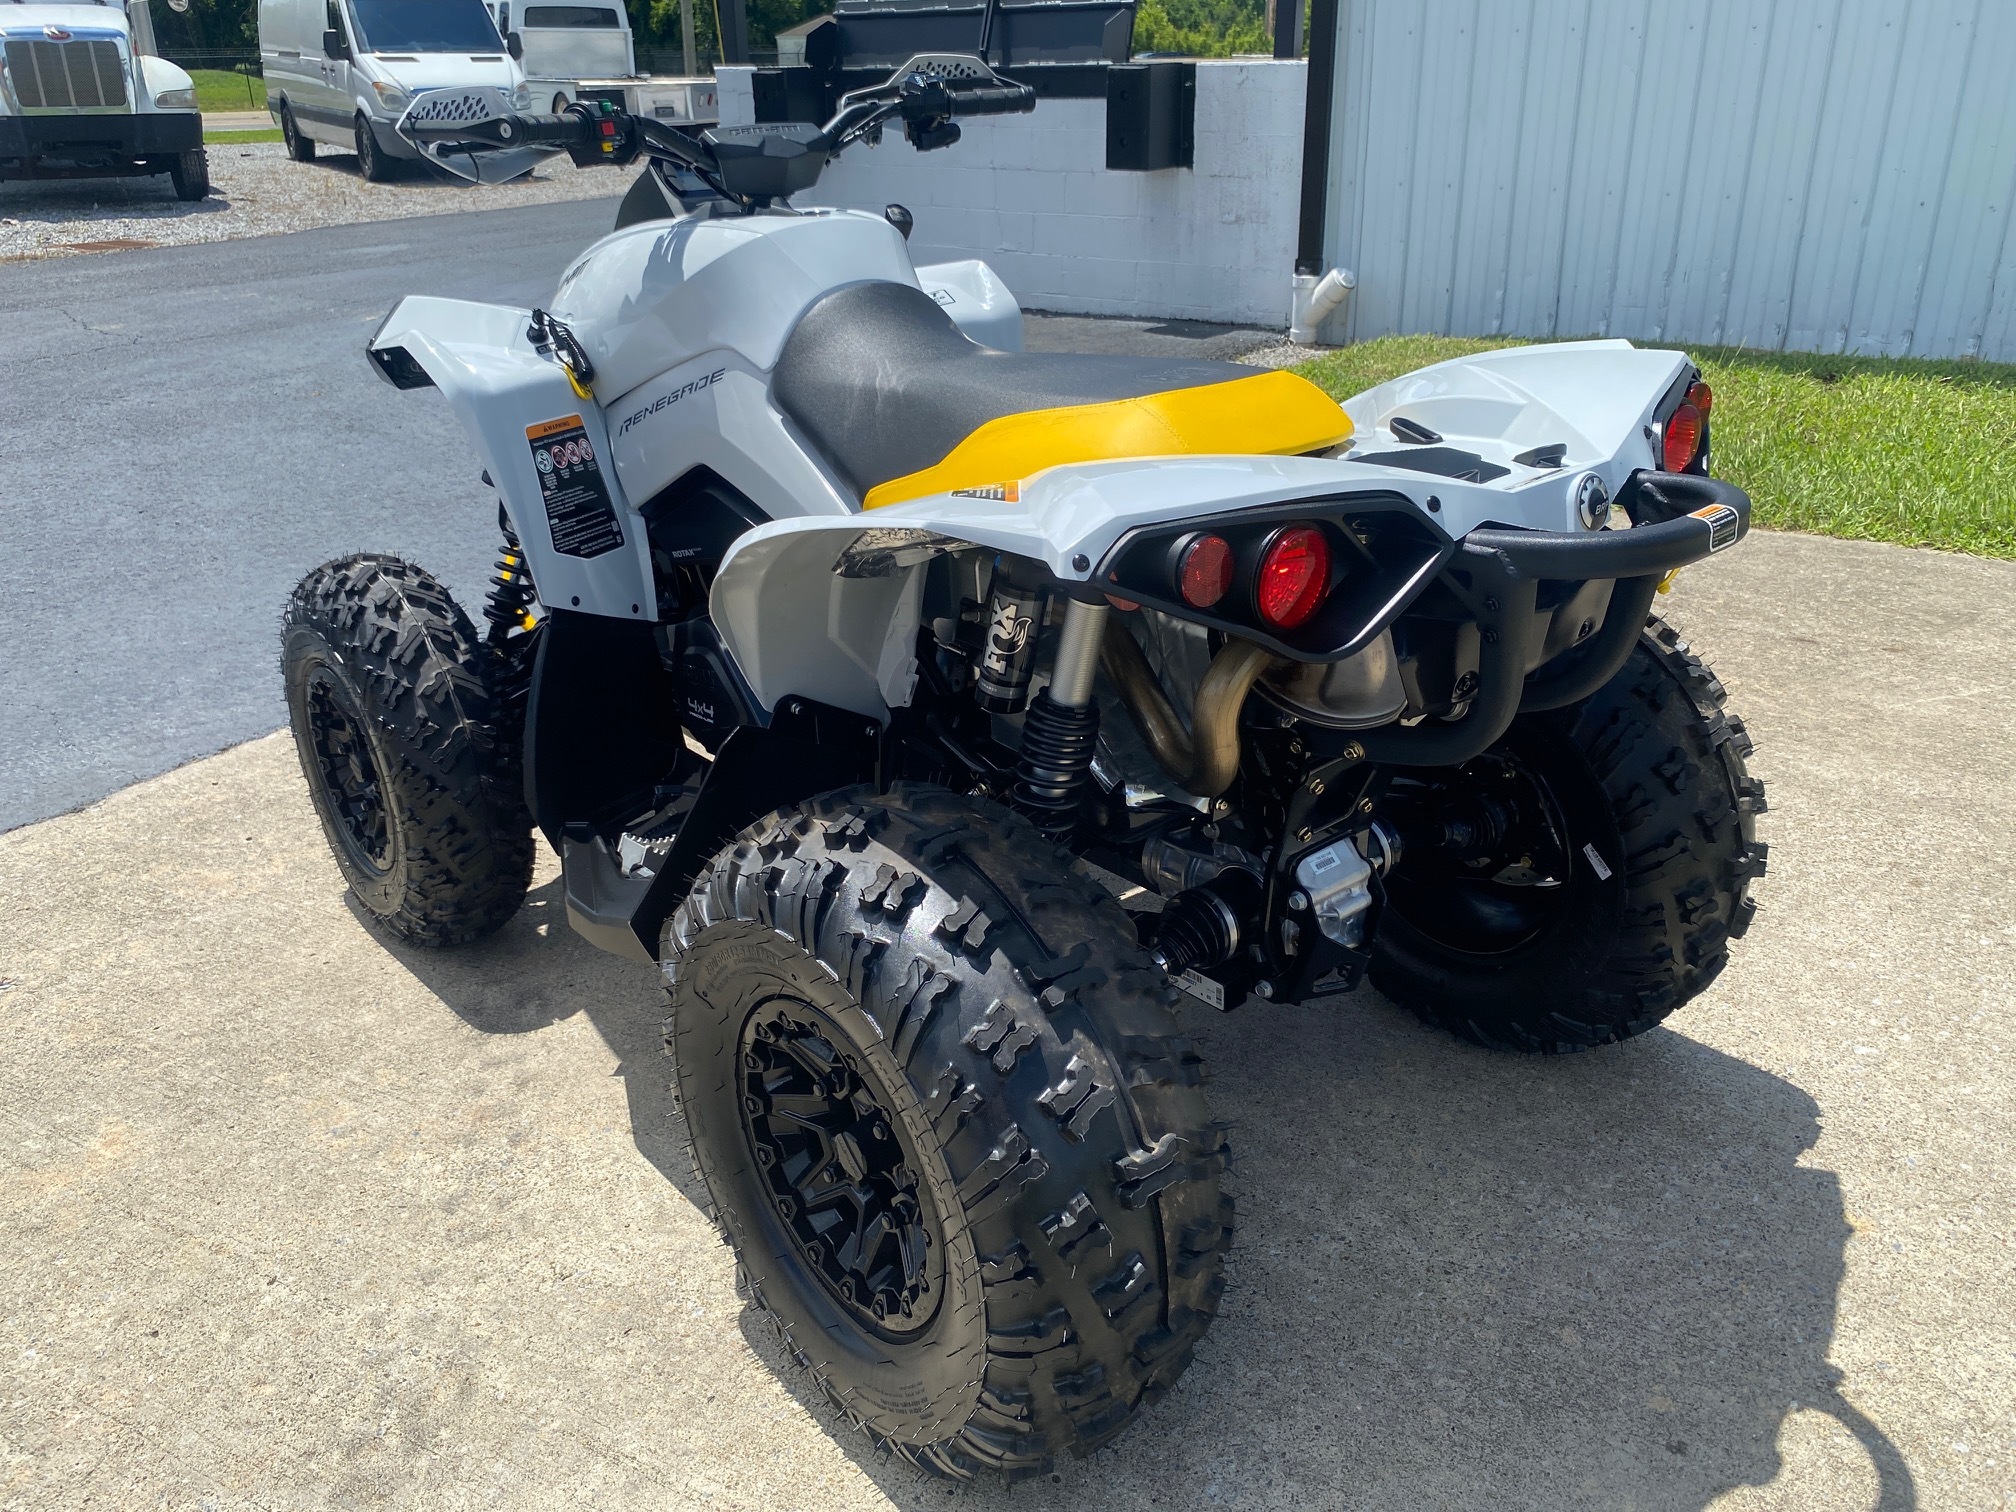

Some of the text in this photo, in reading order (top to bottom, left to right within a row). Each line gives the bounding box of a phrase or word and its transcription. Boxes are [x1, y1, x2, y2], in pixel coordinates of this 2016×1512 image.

[619, 367, 726, 437] RENEGADE
[548, 421, 570, 431] WARNING
[671, 548, 695, 559] ROTAX
[983, 597, 1031, 675] FOX
[687, 697, 714, 718] 4x4
